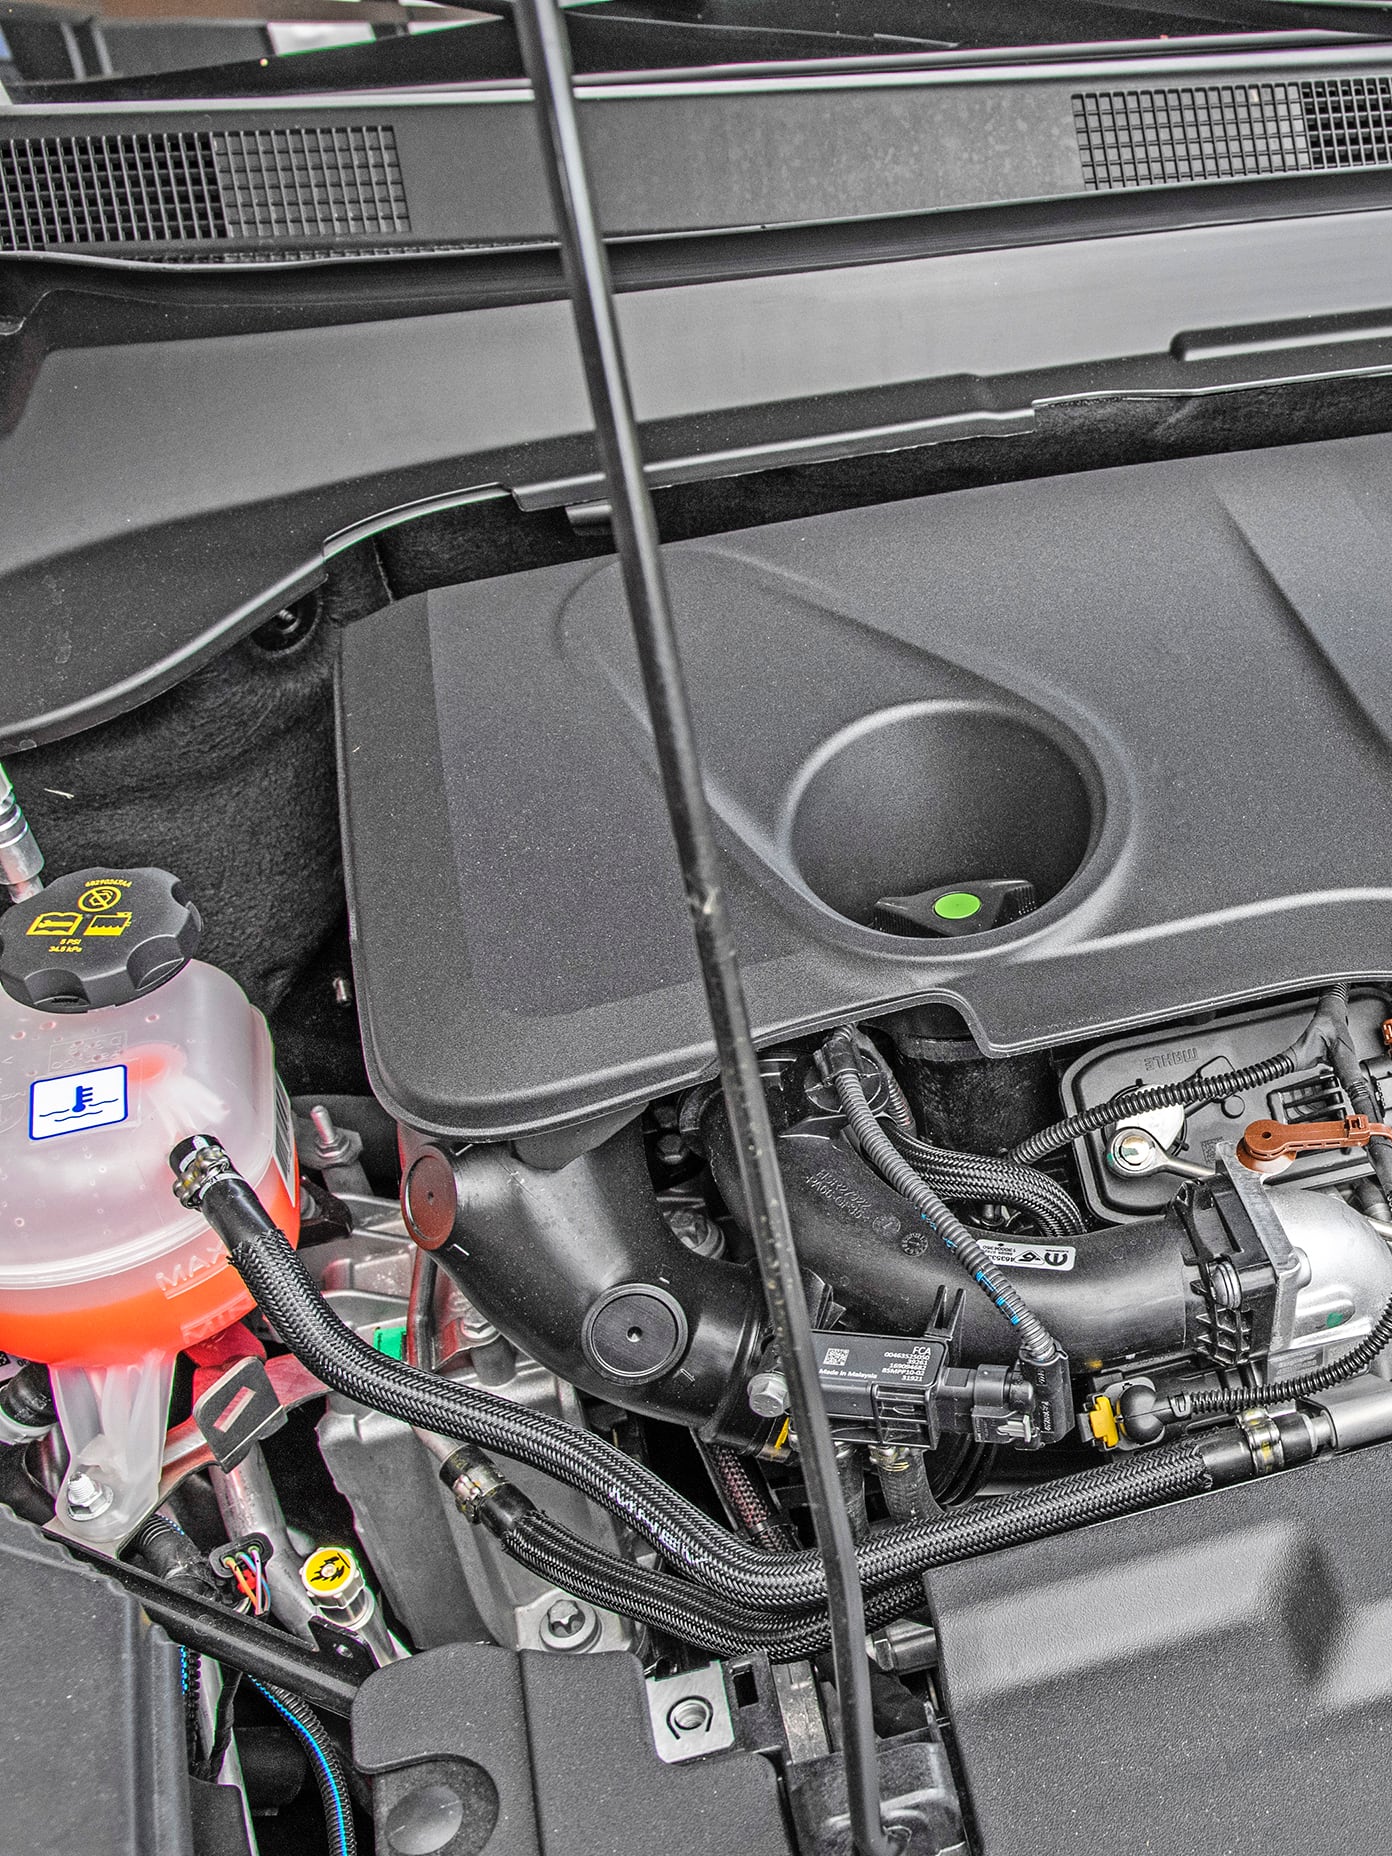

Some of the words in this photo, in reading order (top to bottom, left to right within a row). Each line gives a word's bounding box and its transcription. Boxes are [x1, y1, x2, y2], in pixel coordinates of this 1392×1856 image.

[1143, 1047, 1199, 1072] MAHLE
[154, 1241, 226, 1292] MAX
[912, 1346, 932, 1356] FCA
[818, 1368, 839, 1376] Made
[847, 1371, 878, 1380] Malaysia
